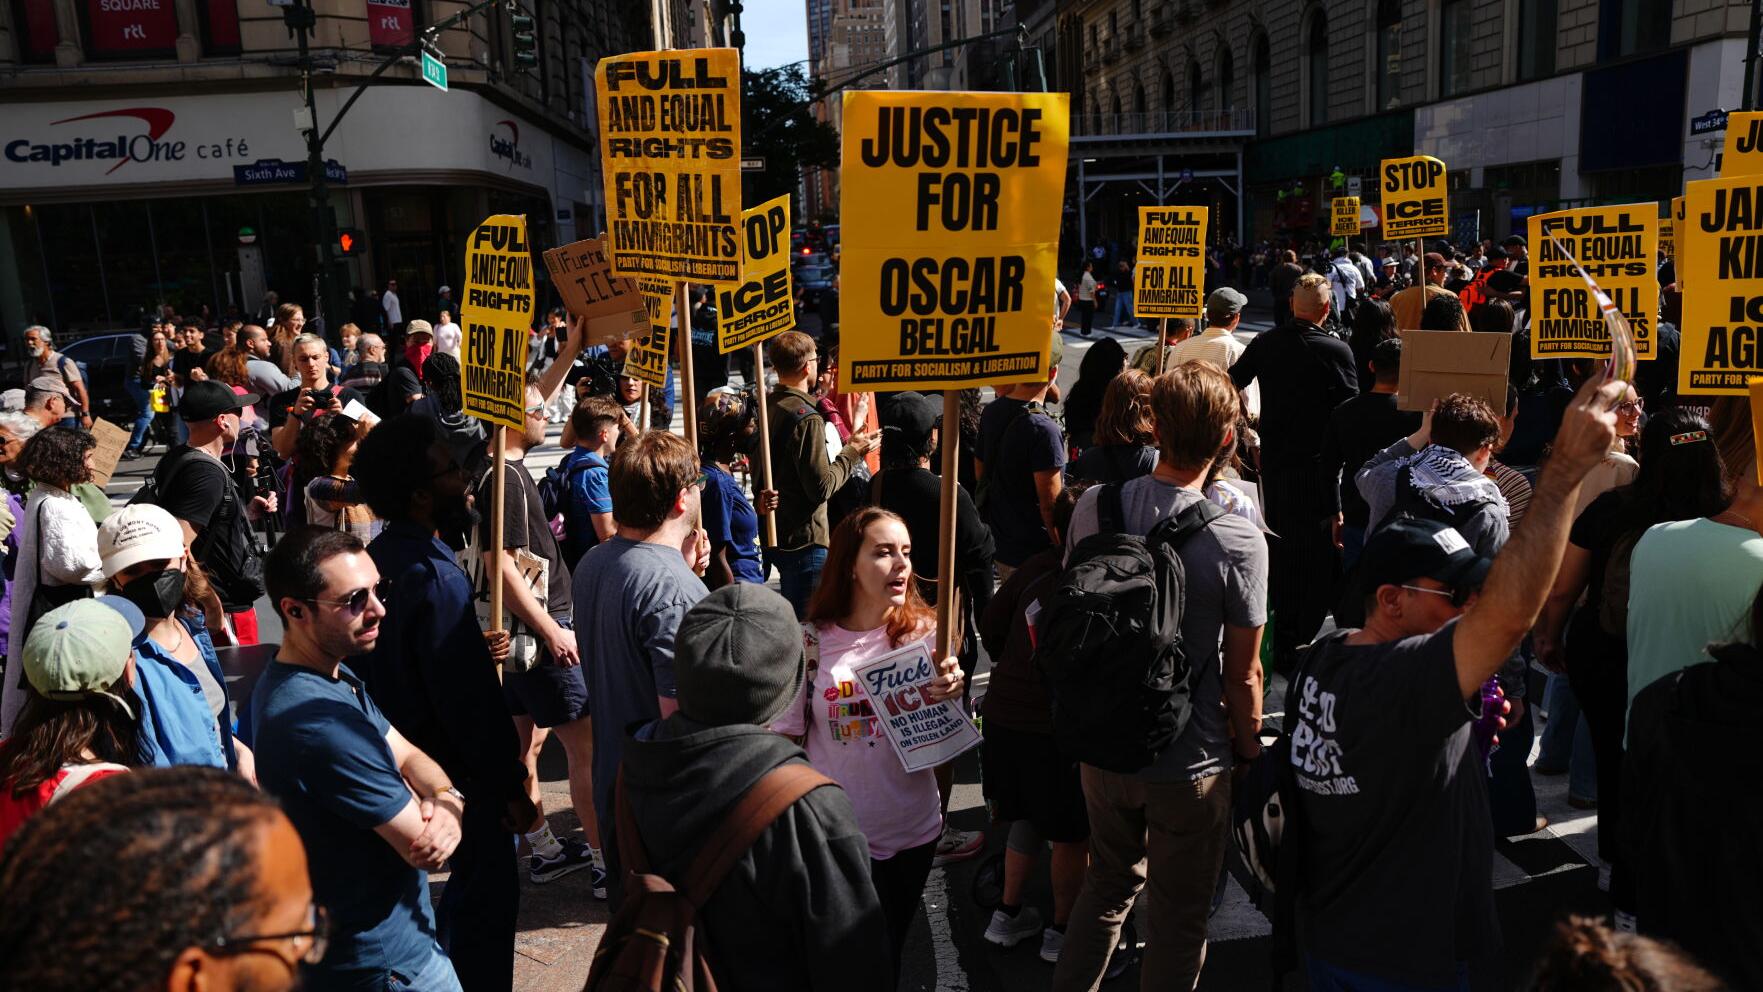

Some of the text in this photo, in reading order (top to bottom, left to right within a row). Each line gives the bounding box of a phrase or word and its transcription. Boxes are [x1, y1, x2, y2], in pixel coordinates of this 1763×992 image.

[100, 0, 160, 11] SQUARE
[606, 58, 728, 91] FULL
[609, 93, 732, 134] AND EQUAL
[197, 139, 249, 159] café
[608, 137, 734, 160] RIGHTS
[861, 106, 1042, 168] JUSTICE
[245, 168, 296, 180] Sixth Ave
[1385, 161, 1443, 192] STOP
[615, 172, 731, 224] FOR ALL
[916, 172, 1000, 232] FOR
[1386, 198, 1444, 220] ICE
[1146, 212, 1200, 225] FULL
[1386, 217, 1444, 228] TERROR
[1541, 213, 1644, 236] FULL
[614, 220, 737, 257] IMMIGRANTS
[1144, 227, 1199, 245] AND EQUAL
[1540, 237, 1575, 262] AND
[1582, 235, 1646, 261] EQUAL
[1142, 246, 1200, 257] RIGHTS
[471, 253, 497, 286] AND
[497, 255, 530, 290] EQUAL
[618, 256, 640, 268] PARTY
[692, 261, 737, 277] LIBERATION
[1141, 266, 1196, 289] FOR ALL
[1539, 262, 1647, 278] RIGHTS
[720, 268, 788, 320] ICE
[880, 256, 1026, 316] OSCAR
[469, 288, 530, 313] RIGHTS
[1544, 288, 1588, 319] FOR
[723, 299, 789, 333] TERROR
[468, 323, 495, 368] FOR
[899, 316, 1000, 356] BELGAL
[1560, 341, 1572, 350] FOR
[855, 356, 1037, 379] PARTY FOR SOCIALISM & LIBERATION
[1693, 374, 1722, 385] PARTY
[1724, 374, 1742, 385] FOR
[866, 656, 931, 696] Fuck
[890, 703, 949, 729] NO HUMAN
[900, 715, 953, 738] IS ILLEGAL
[900, 719, 964, 748] ON STOLEN LAND
